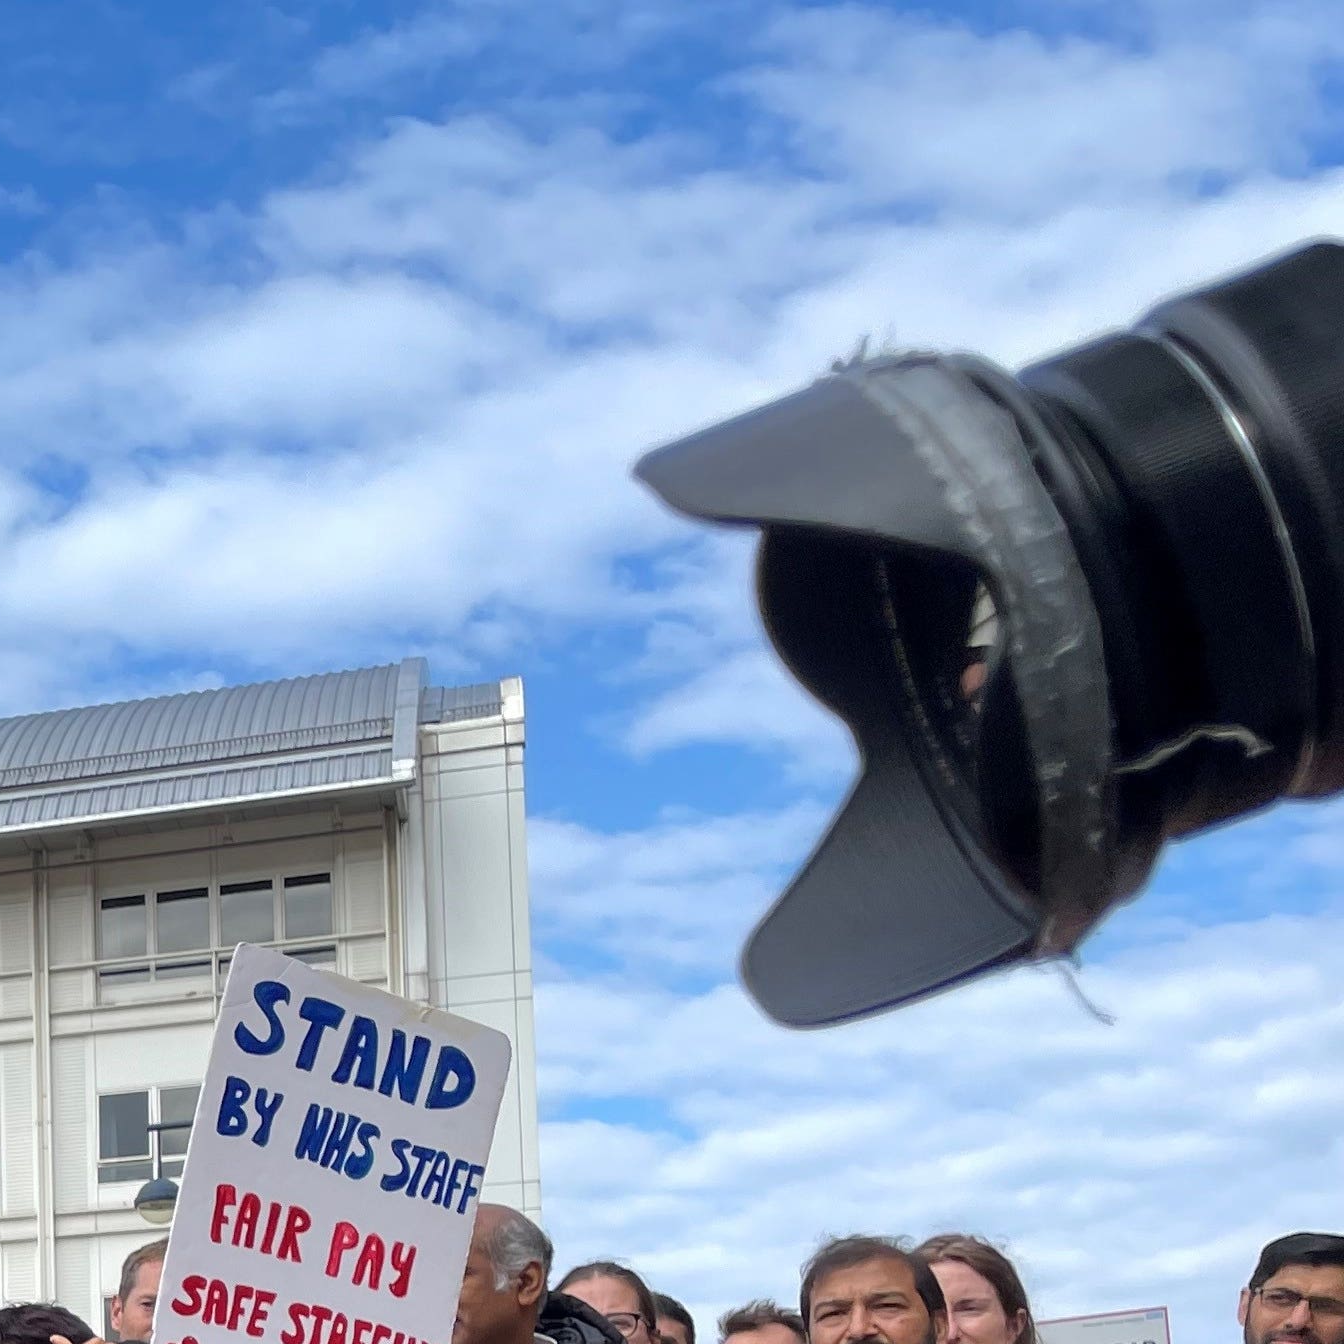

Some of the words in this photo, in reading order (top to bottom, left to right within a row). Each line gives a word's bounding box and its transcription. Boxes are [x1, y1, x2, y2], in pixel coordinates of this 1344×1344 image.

[234, 980, 476, 1111] STAND
[216, 1075, 283, 1147] BY
[295, 1103, 381, 1180] NHS
[381, 1138, 484, 1215] STAFF
[210, 1183, 312, 1264] FAIR
[325, 1221, 417, 1298] PAY
[171, 1274, 277, 1338] SAFE
